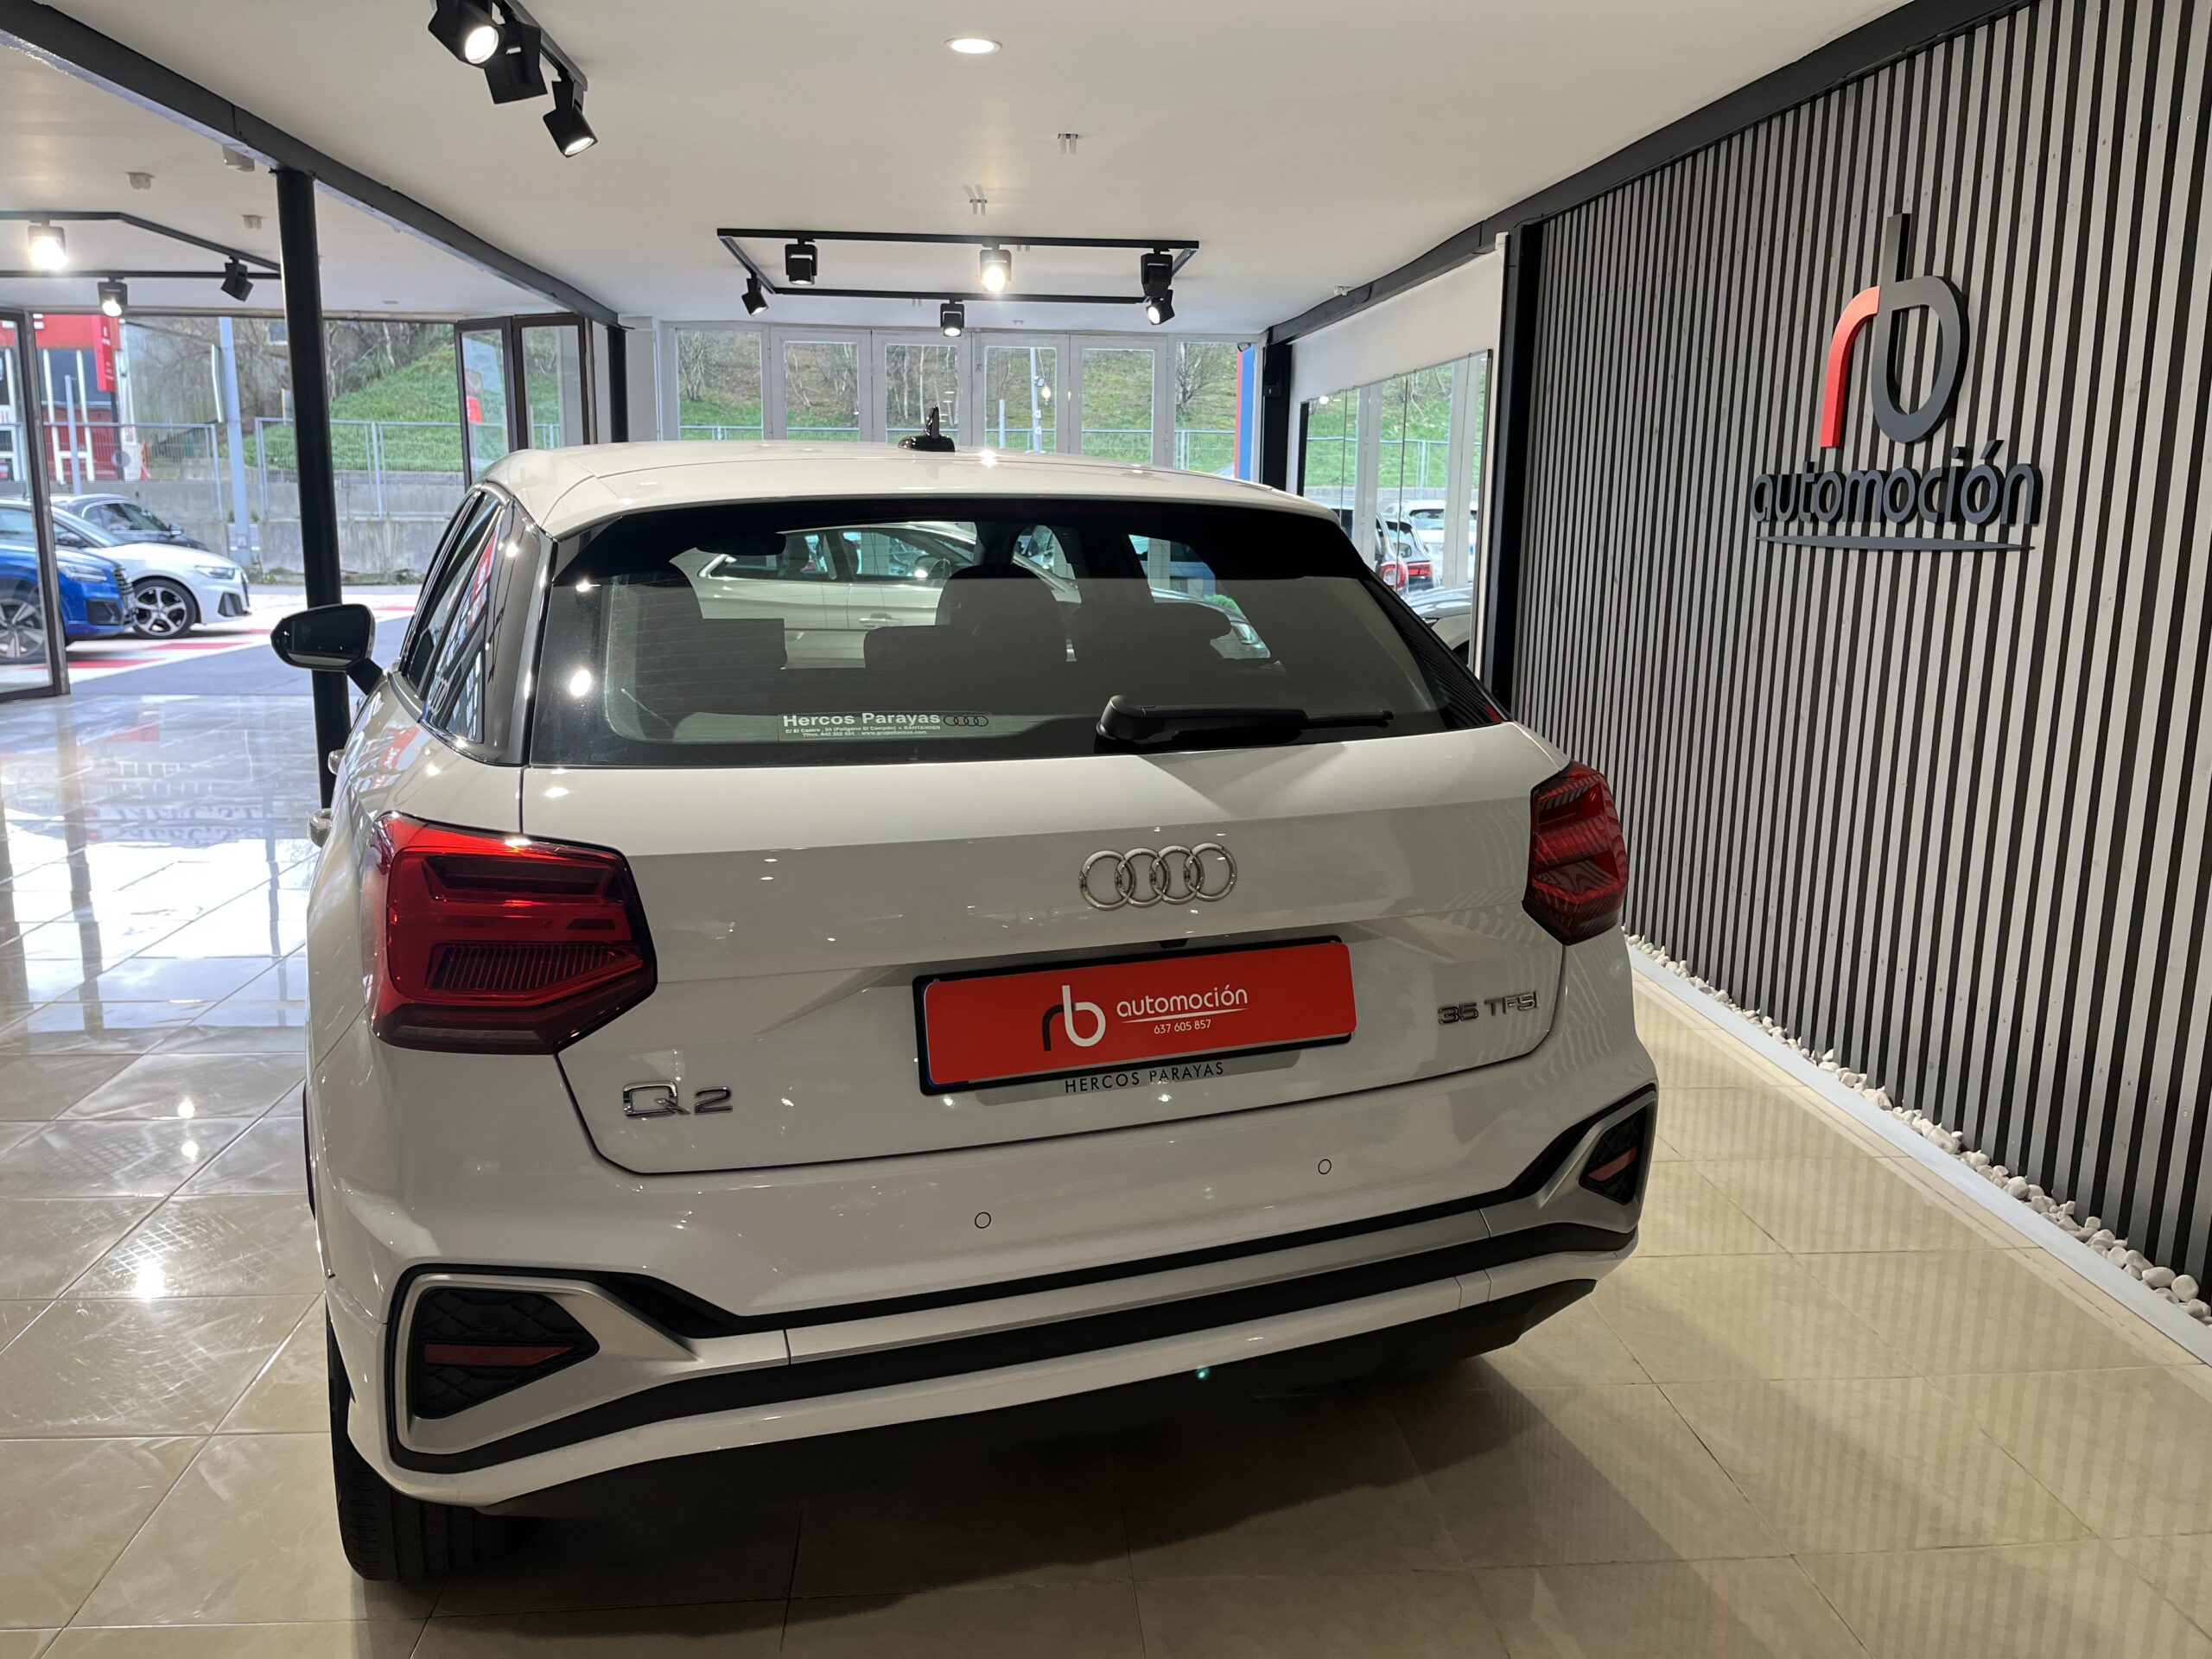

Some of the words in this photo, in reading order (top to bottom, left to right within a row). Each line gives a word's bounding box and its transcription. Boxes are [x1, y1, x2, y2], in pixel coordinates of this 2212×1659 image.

[1751, 440, 2044, 524] automoción
[783, 715, 855, 727] Hercos
[862, 713, 941, 727] Parayas
[1116, 984, 1248, 1018] automoción
[1438, 1001, 1479, 1026] 35
[1484, 991, 1539, 1017] TFSI
[1154, 1023, 1171, 1035] 637
[1173, 1020, 1192, 1033] 605
[1194, 1019, 1211, 1030] 857
[1065, 1071, 1140, 1094] HERCOS
[1149, 1061, 1224, 1084] PARAYAS
[623, 1080, 733, 1119] Q2
